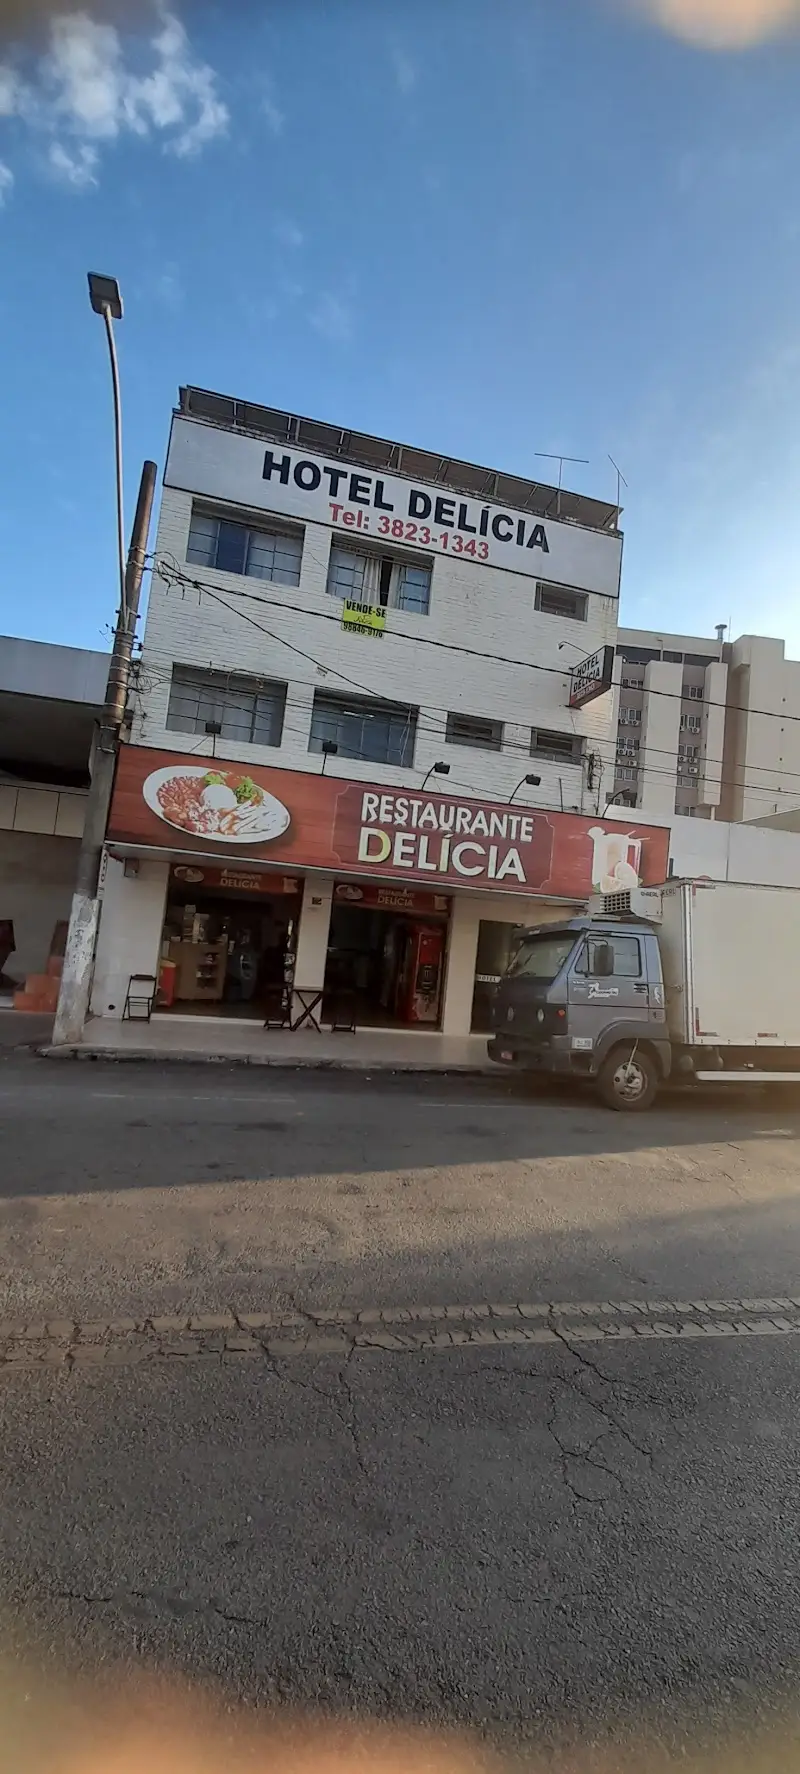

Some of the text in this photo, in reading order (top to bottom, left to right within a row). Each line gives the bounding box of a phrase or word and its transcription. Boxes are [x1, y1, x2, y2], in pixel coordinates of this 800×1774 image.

[262, 450, 549, 553] HOTEL DELÍCIA
[329, 502, 490, 560] Tel: 3823-1343
[346, 600, 386, 618] VENDE-SE
[577, 655, 599, 677] HOTEL
[362, 792, 534, 842] RESTAURANTE
[358, 827, 527, 883] DELÍCIA
